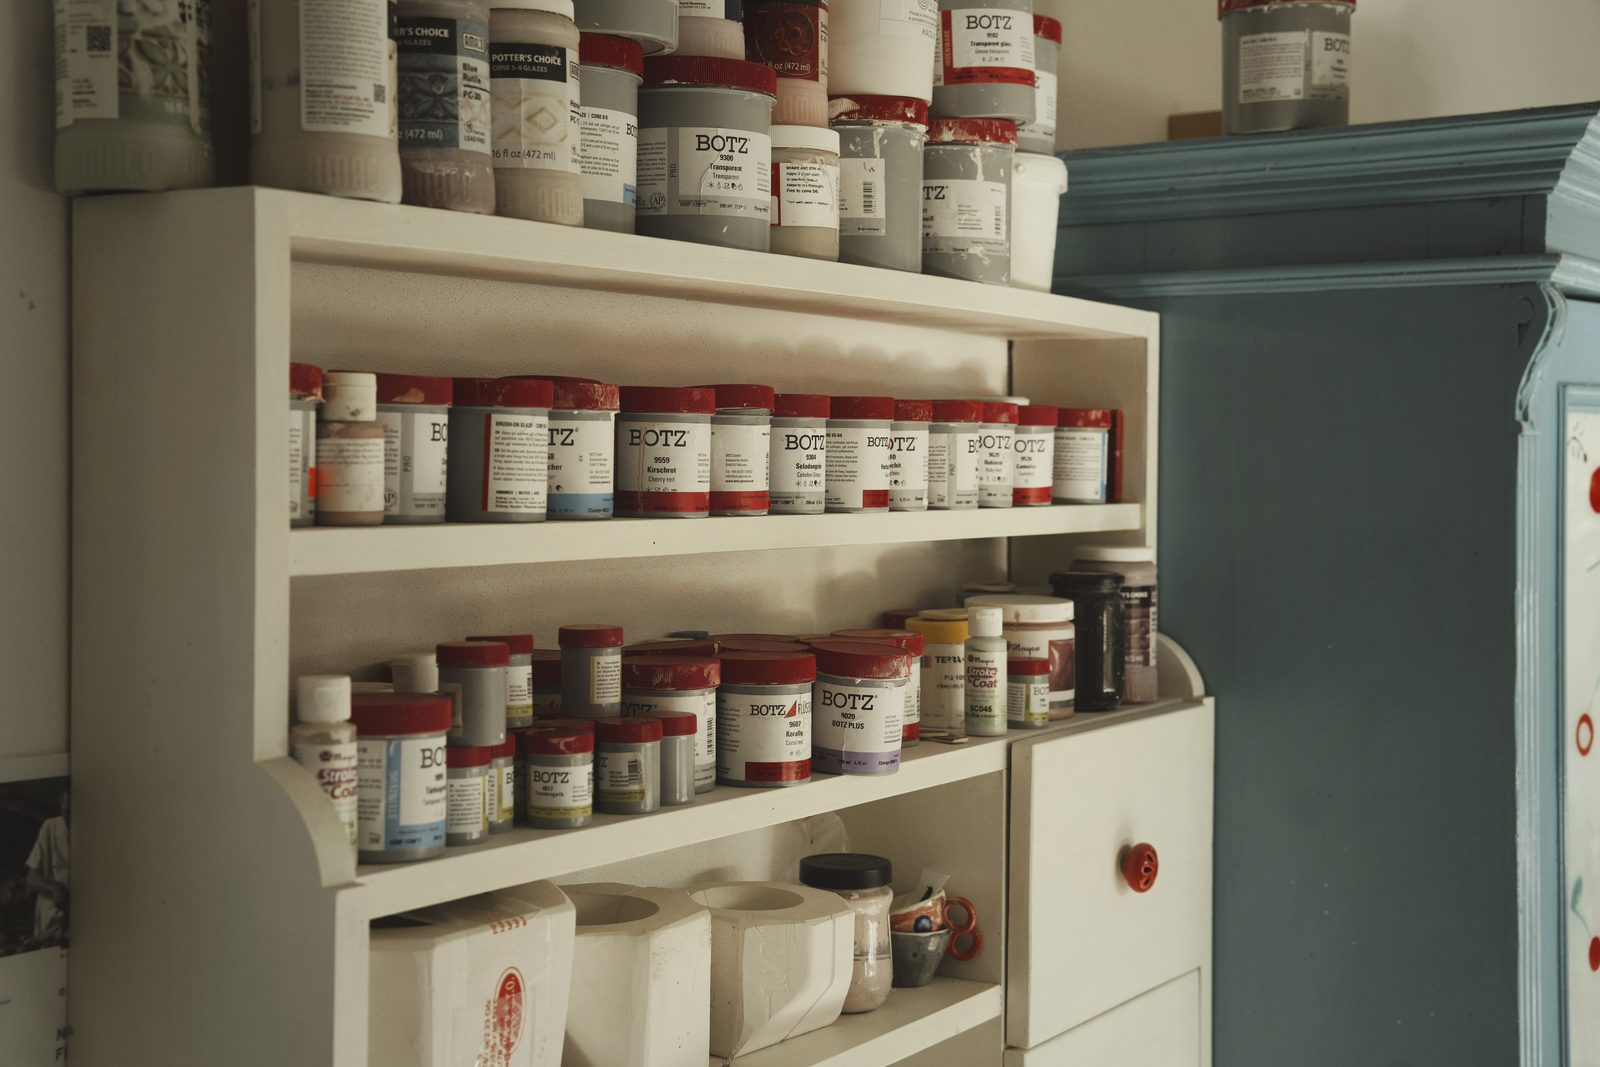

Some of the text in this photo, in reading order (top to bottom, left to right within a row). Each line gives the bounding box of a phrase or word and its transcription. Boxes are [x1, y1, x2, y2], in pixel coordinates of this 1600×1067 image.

[966, 15, 1012, 30] BOTZ
[415, 28, 449, 38] CHOICE
[492, 54, 562, 66] POTTER'S CHOICE
[463, 63, 478, 72] Blue
[784, 61, 799, 71] (472
[800, 62, 811, 72] ml)
[405, 129, 426, 141] (472
[428, 129, 443, 141] ml)
[696, 135, 748, 154] BOTZ
[492, 149, 501, 159] 16
[503, 148, 509, 159] fl
[523, 149, 541, 160] (472
[543, 151, 556, 161] ml)
[669, 163, 677, 178] PRO
[709, 163, 743, 172] Transparent
[713, 172, 740, 180] Transparent
[629, 429, 687, 447] BOTZ
[785, 434, 825, 450] BOTZ
[654, 456, 670, 464] 9559
[647, 466, 677, 474] Kirschrot
[648, 475, 665, 484] Cherry
[972, 678, 998, 688] Coat
[821, 689, 874, 711] BOTZ
[750, 704, 786, 716] BOTZ
[841, 712, 856, 720] 9020
[831, 720, 865, 730] BOTZ PLUS
[786, 730, 804, 738] Koralle
[533, 770, 569, 783] BOTZ
